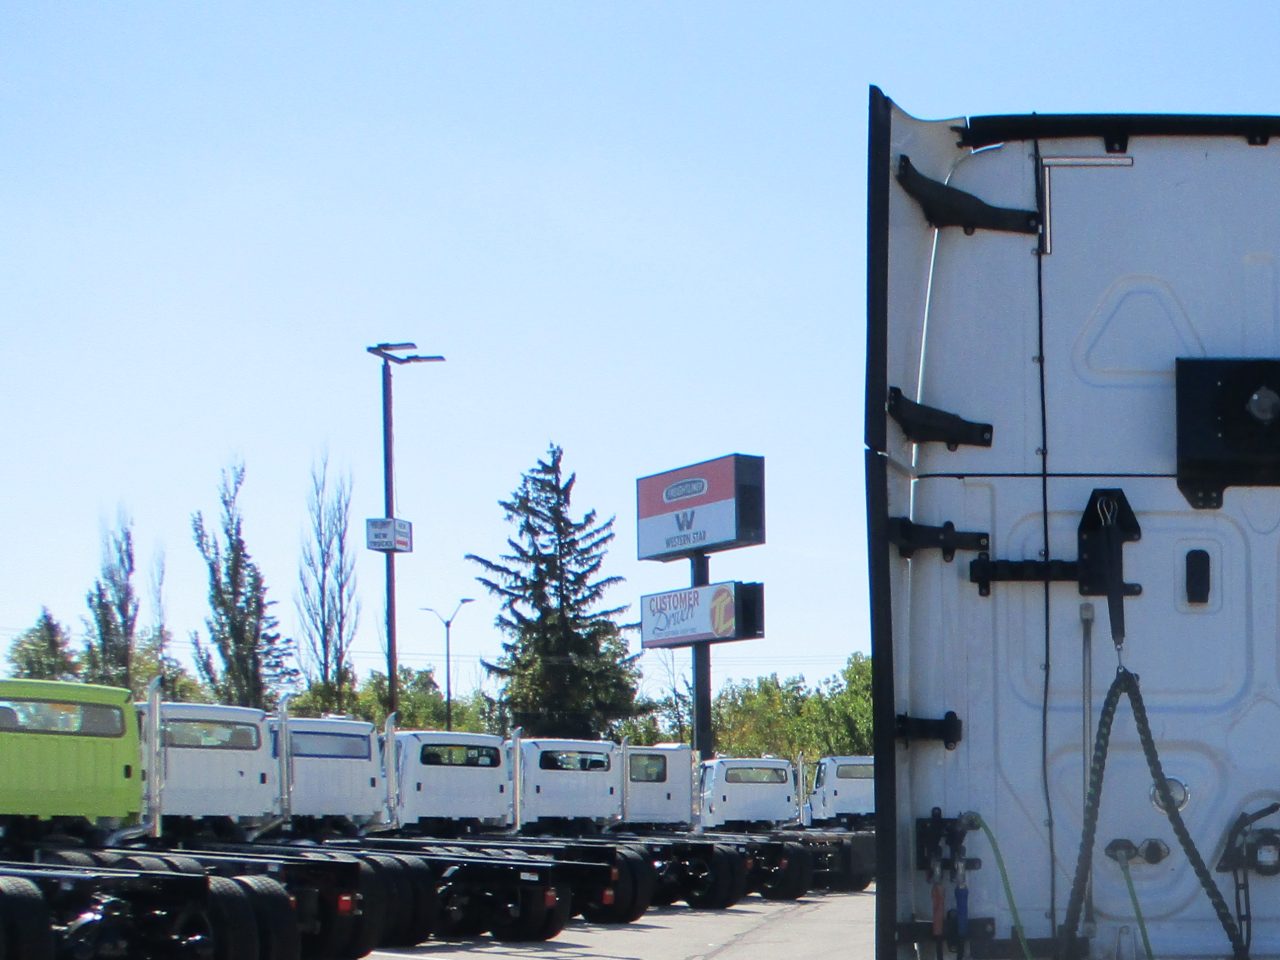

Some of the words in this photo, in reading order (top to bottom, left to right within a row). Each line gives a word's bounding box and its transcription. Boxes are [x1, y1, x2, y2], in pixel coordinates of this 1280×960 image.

[665, 533, 691, 548] WESTERN
[692, 530, 706, 544] STAR
[649, 590, 699, 613] CUSTOMER
